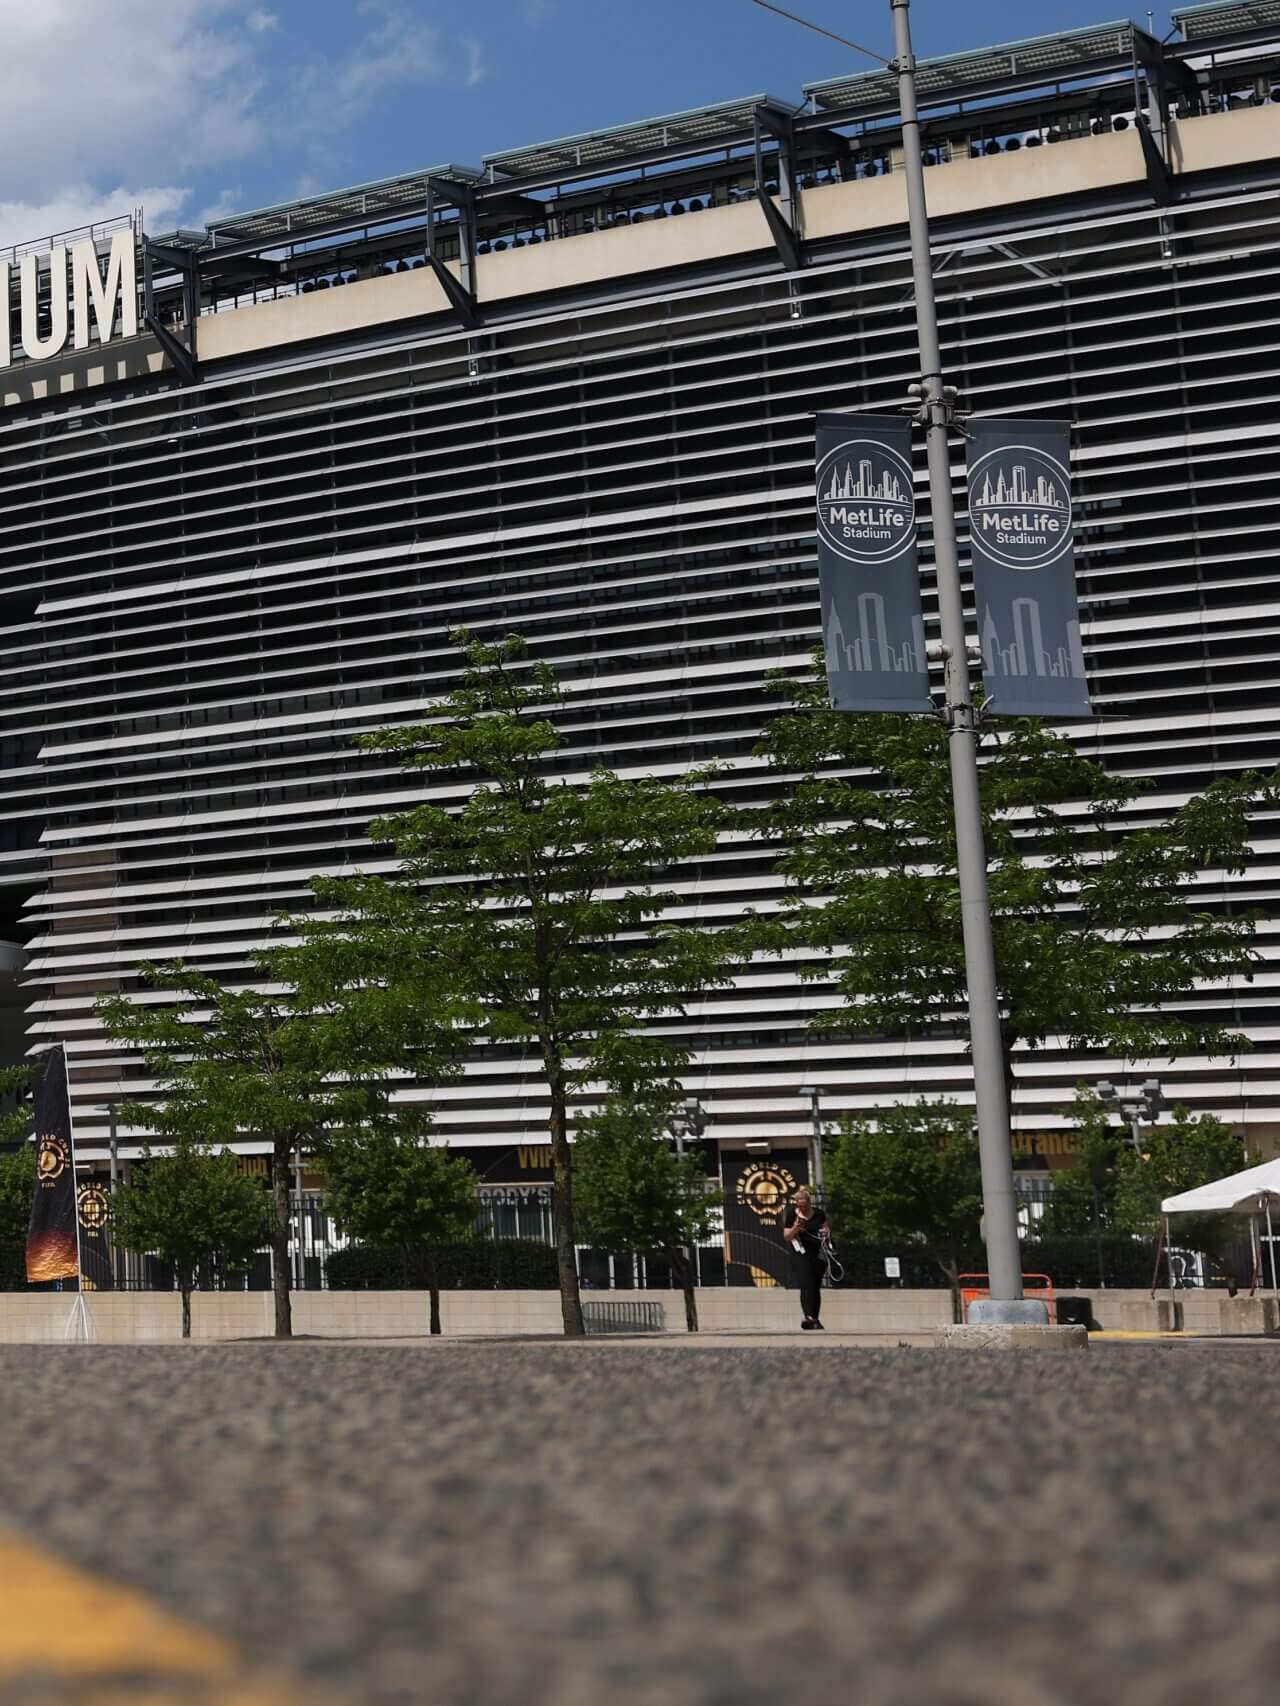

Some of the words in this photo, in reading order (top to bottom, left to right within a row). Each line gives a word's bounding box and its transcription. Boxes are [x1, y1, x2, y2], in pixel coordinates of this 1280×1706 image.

[829, 507, 905, 527] MetLife
[982, 513, 1060, 532] MetLife
[842, 527, 892, 540] Stadium
[996, 532, 1047, 545] Stadium
